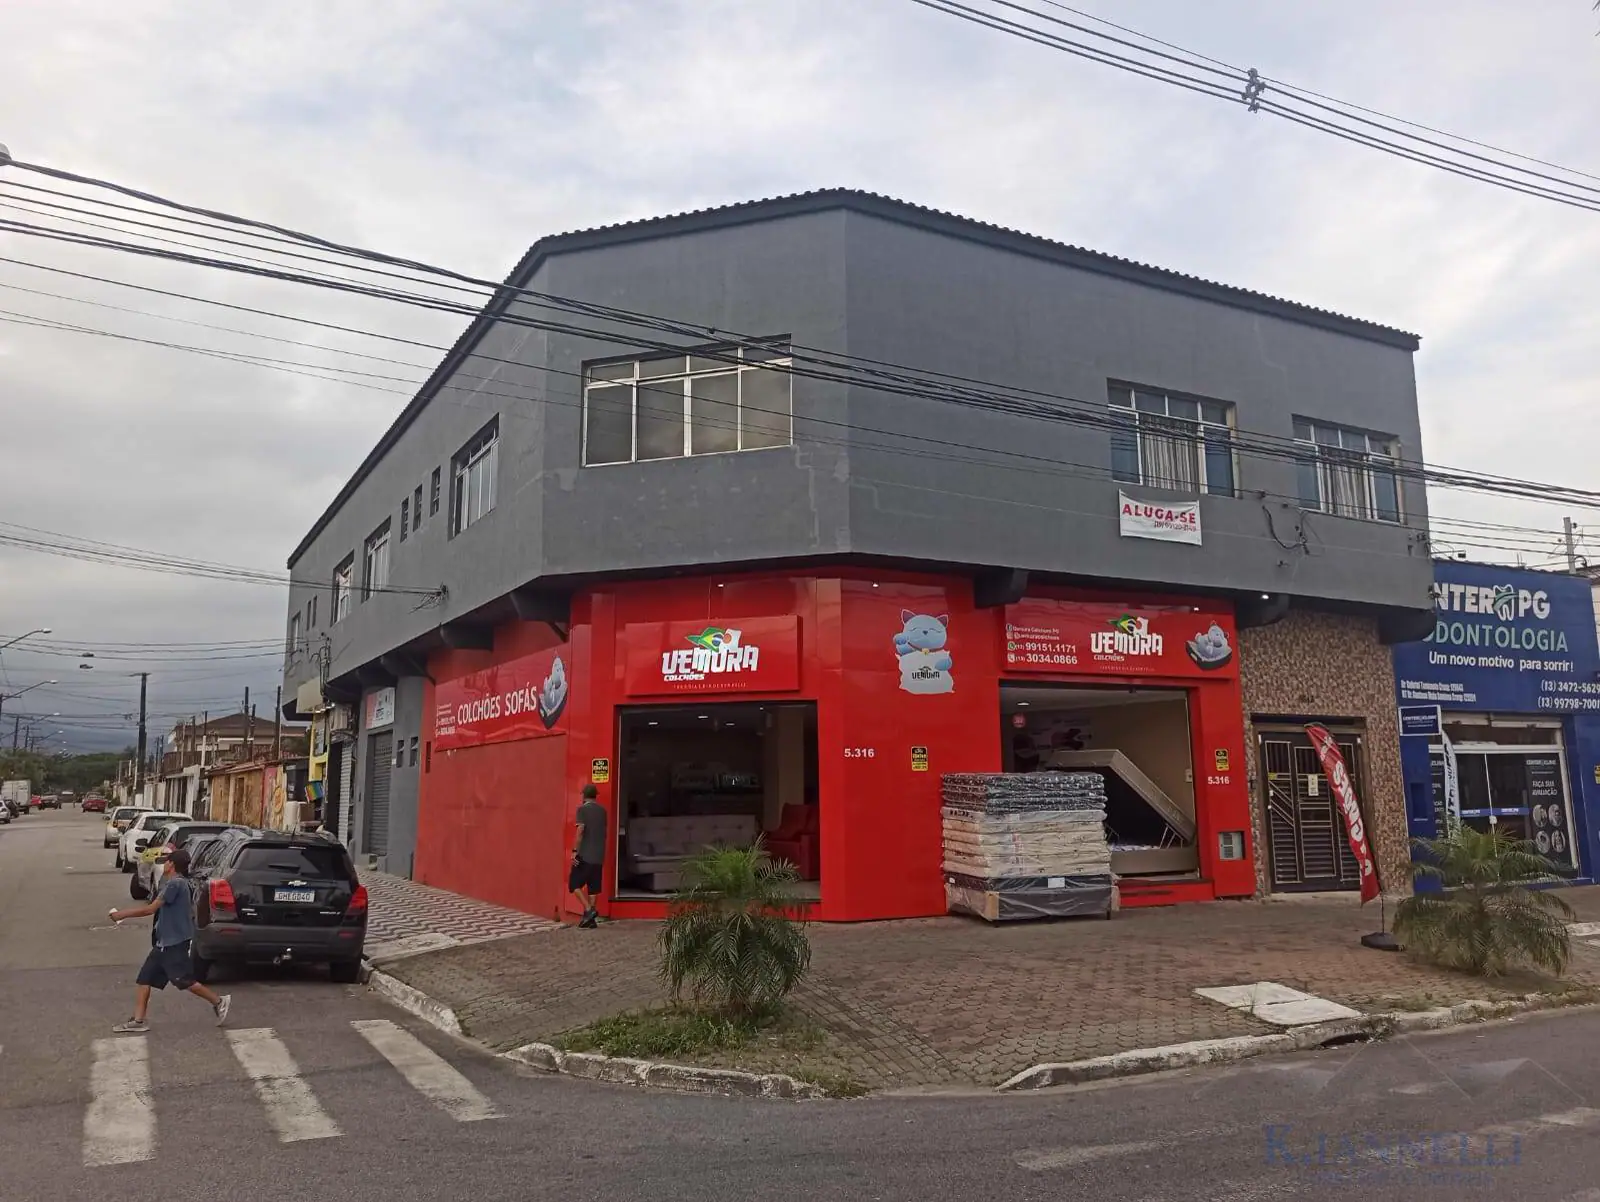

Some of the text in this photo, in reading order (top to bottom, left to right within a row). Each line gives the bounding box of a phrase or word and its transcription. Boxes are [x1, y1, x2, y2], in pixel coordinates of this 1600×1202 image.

[1122, 503, 1196, 524] ALUGA-SE
[1518, 590, 1550, 619] PG
[1025, 642, 1076, 653] 99151.1171
[1026, 653, 1078, 664] 3034.0866
[1429, 651, 1447, 665] Um
[1450, 655, 1476, 667] novo
[1478, 655, 1514, 669] motivo
[1519, 659, 1542, 671] para
[664, 671, 705, 681] COLCHÕES
[1541, 680, 1600, 694] (13) 3472-5629
[457, 682, 537, 725] COLCHÕES SOFÁS
[1537, 696, 1600, 709] (13) 99798-7001
[844, 748, 875, 758] 5.316
[1207, 776, 1230, 785] 5.316
